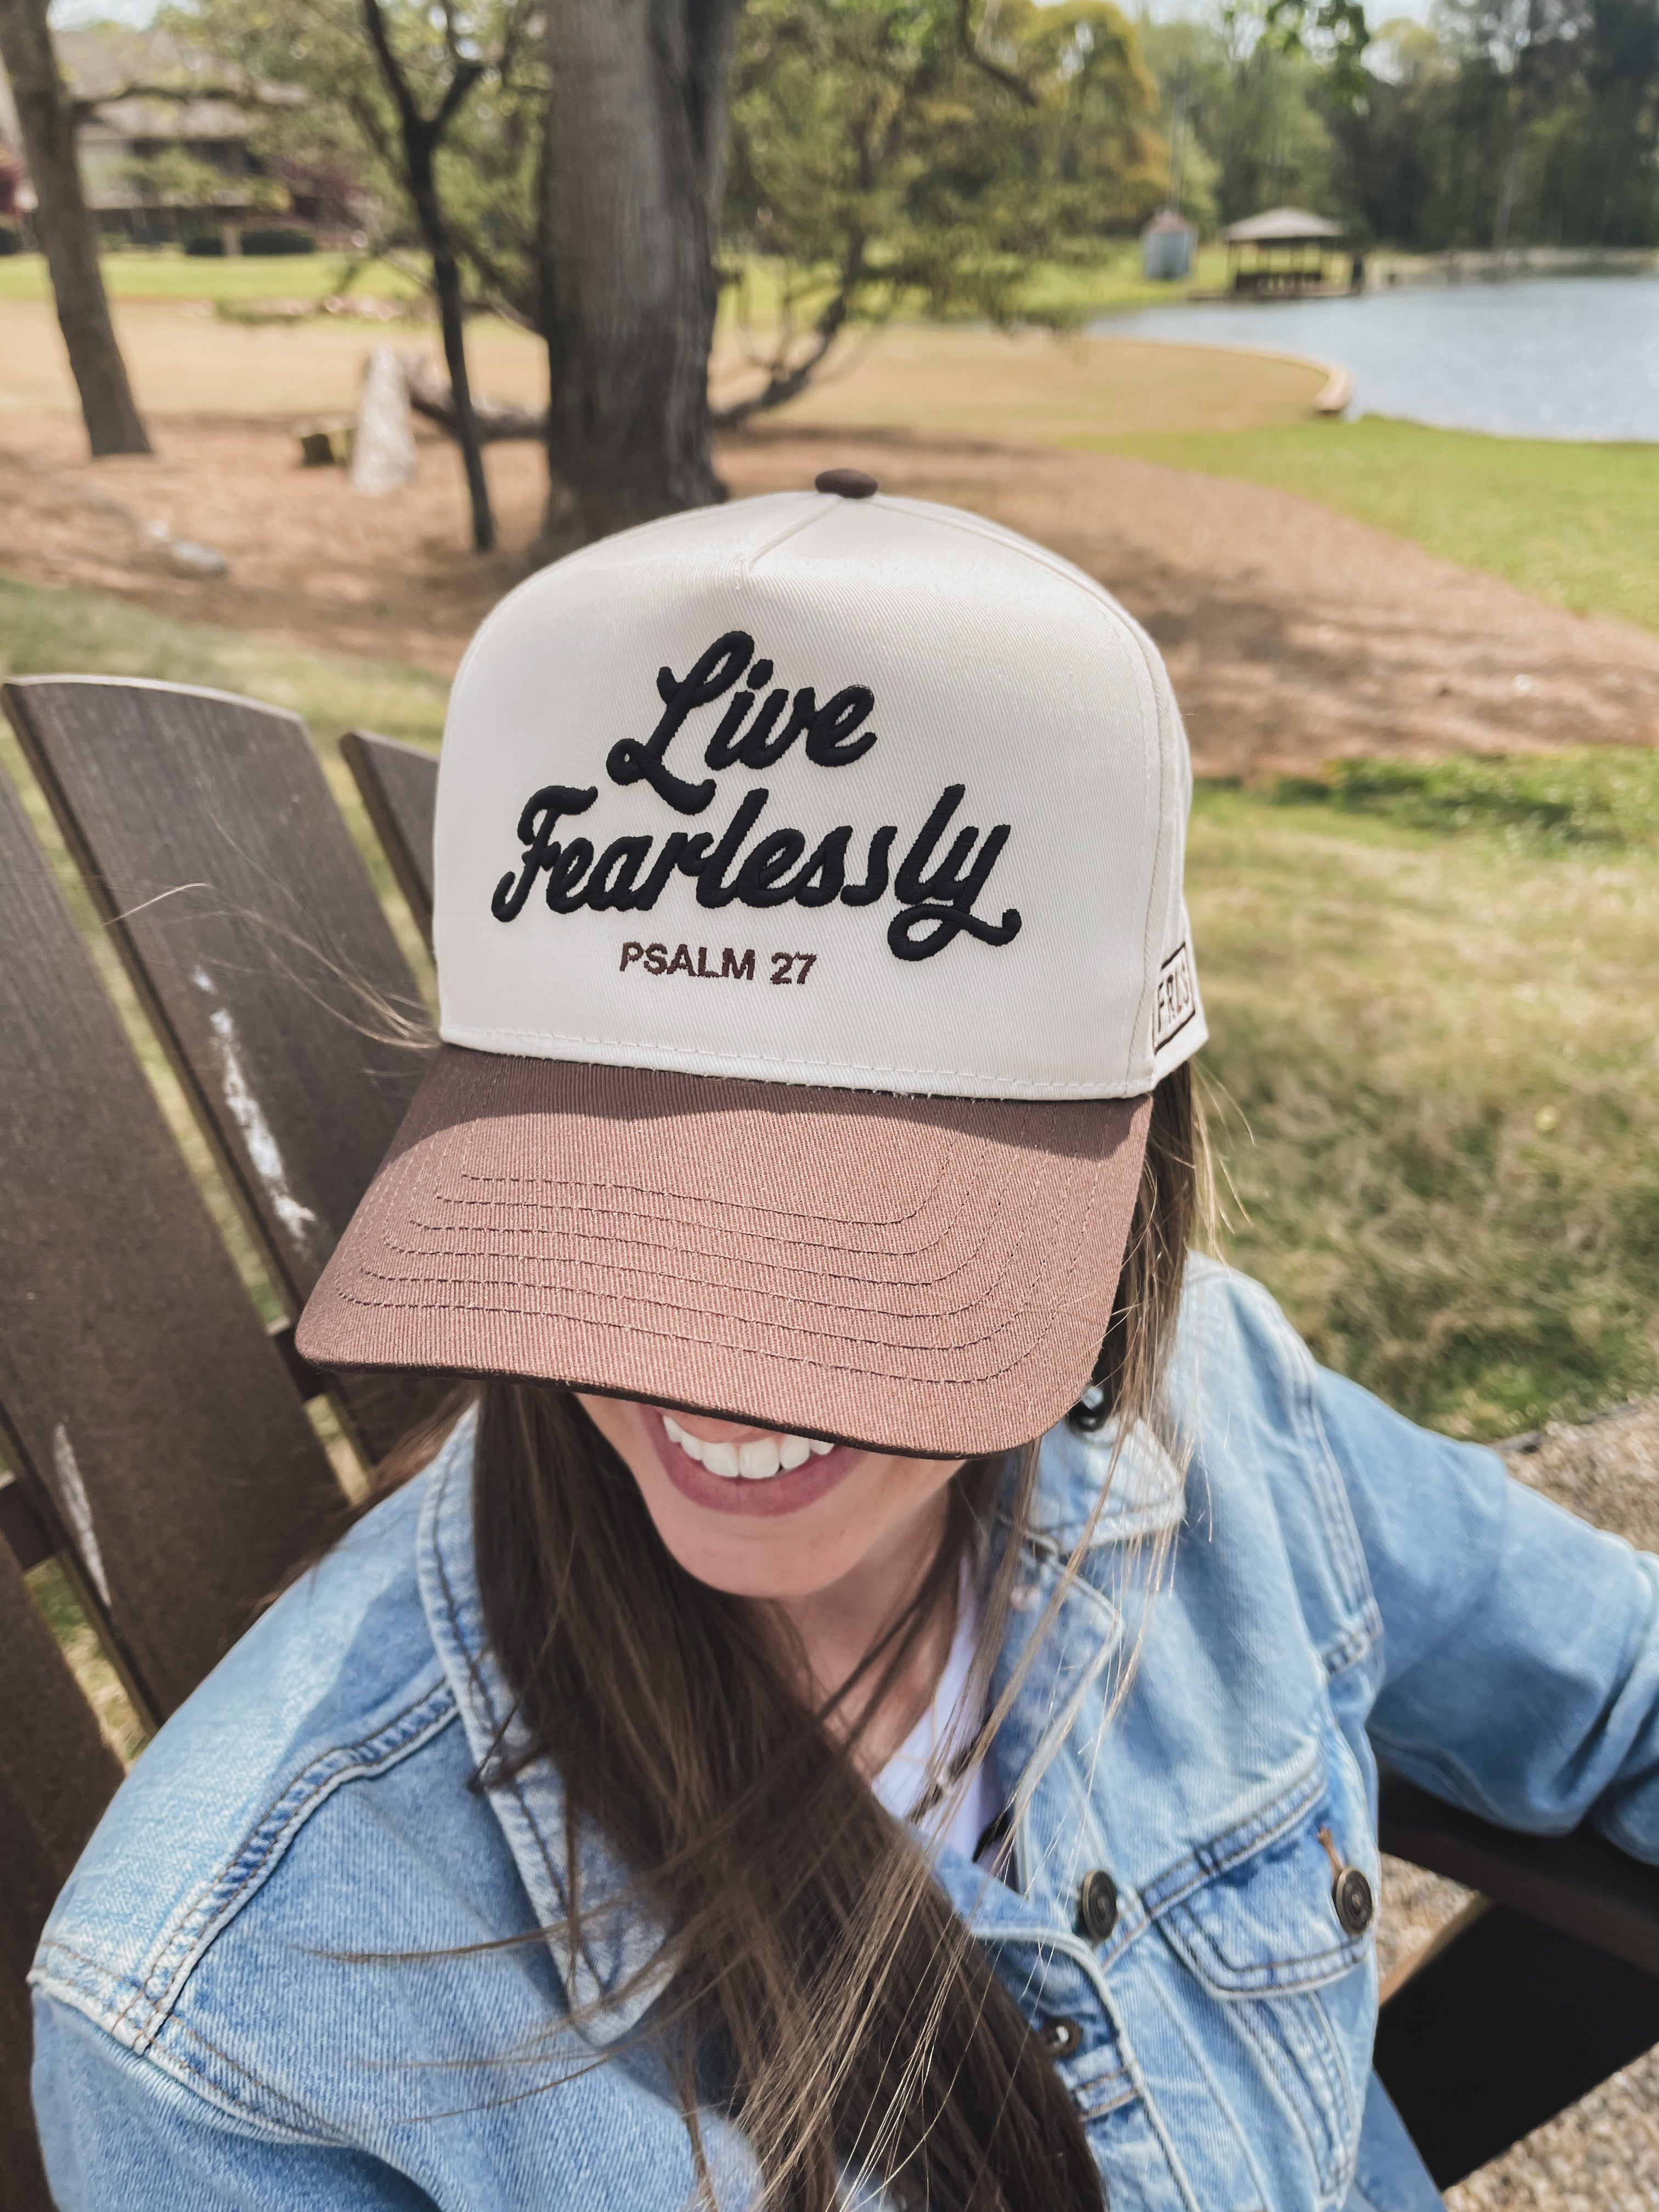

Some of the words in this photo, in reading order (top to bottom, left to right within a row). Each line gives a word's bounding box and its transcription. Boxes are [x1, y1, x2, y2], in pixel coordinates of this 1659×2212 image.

[606, 630, 878, 816] Live
[491, 783, 1022, 962] Fearlessly
[619, 941, 756, 980] PSALM
[770, 951, 817, 985] 27
